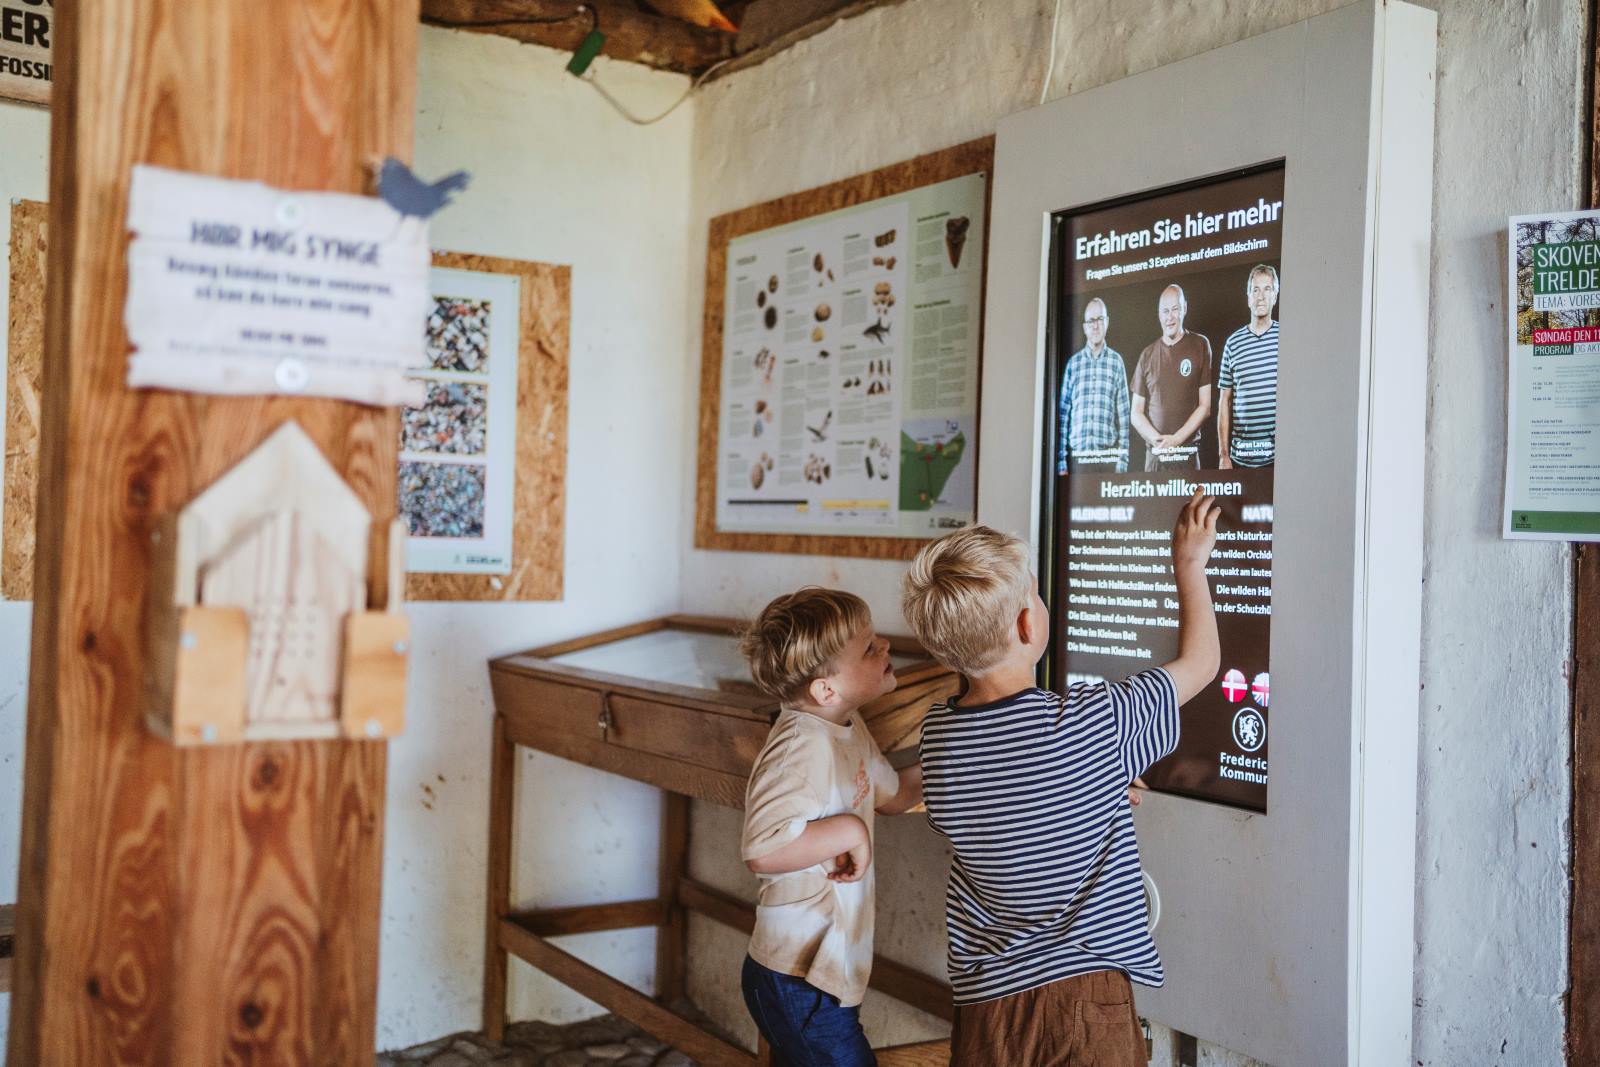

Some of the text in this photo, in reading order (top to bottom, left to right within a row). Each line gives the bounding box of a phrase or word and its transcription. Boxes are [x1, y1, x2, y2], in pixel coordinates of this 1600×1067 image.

[0, 7, 49, 48] ER
[1076, 199, 1283, 260] Erfahren Sie hier mehr
[1086, 238, 1268, 280] Fragen Sie unsere 3 Experten auf dem Bildschirm
[1537, 269, 1600, 292] TRELDE
[1537, 296, 1566, 309] TEMA:
[1535, 331, 1572, 343] SØNDAG
[1573, 330, 1591, 342] DEN
[1535, 345, 1571, 355] PROGRAM
[1575, 344, 1586, 353] OG
[1101, 480, 1154, 498] Herzlich
[1070, 530, 1085, 540] Was
[1085, 530, 1094, 540] ist
[1094, 530, 1106, 540] der
[1106, 530, 1140, 541] Naturpark
[1069, 545, 1082, 555] Der
[1123, 546, 1132, 555] im
[1133, 547, 1158, 556] Kleinen
[1211, 549, 1222, 558] die
[1223, 549, 1246, 558] wilden
[1120, 563, 1128, 572] im
[1128, 564, 1152, 573] Kleinen
[1152, 564, 1166, 573] Belt
[1205, 566, 1220, 576] osch
[1220, 566, 1239, 577] quakt
[1155, 582, 1177, 592] finden
[1216, 584, 1230, 594] Die
[1231, 585, 1257, 596] wilden
[1090, 595, 1107, 605] Wale
[1107, 596, 1116, 606] im
[1116, 597, 1142, 607] Kleinen
[1143, 598, 1157, 608] Belt
[1164, 597, 1179, 609] Übe
[1214, 602, 1222, 612] in
[1222, 602, 1236, 613] der
[1068, 610, 1080, 620] Die
[1101, 613, 1115, 623] und
[1115, 613, 1127, 623] das
[1146, 617, 1157, 626] am
[1157, 616, 1179, 628] Kleine
[1088, 627, 1097, 637] im
[1097, 628, 1122, 639] Kleinen
[1123, 630, 1137, 641] Belt
[1067, 642, 1079, 652] Die
[1101, 646, 1111, 655] am
[1111, 646, 1137, 657] Kleinen
[1137, 648, 1152, 659] Belt
